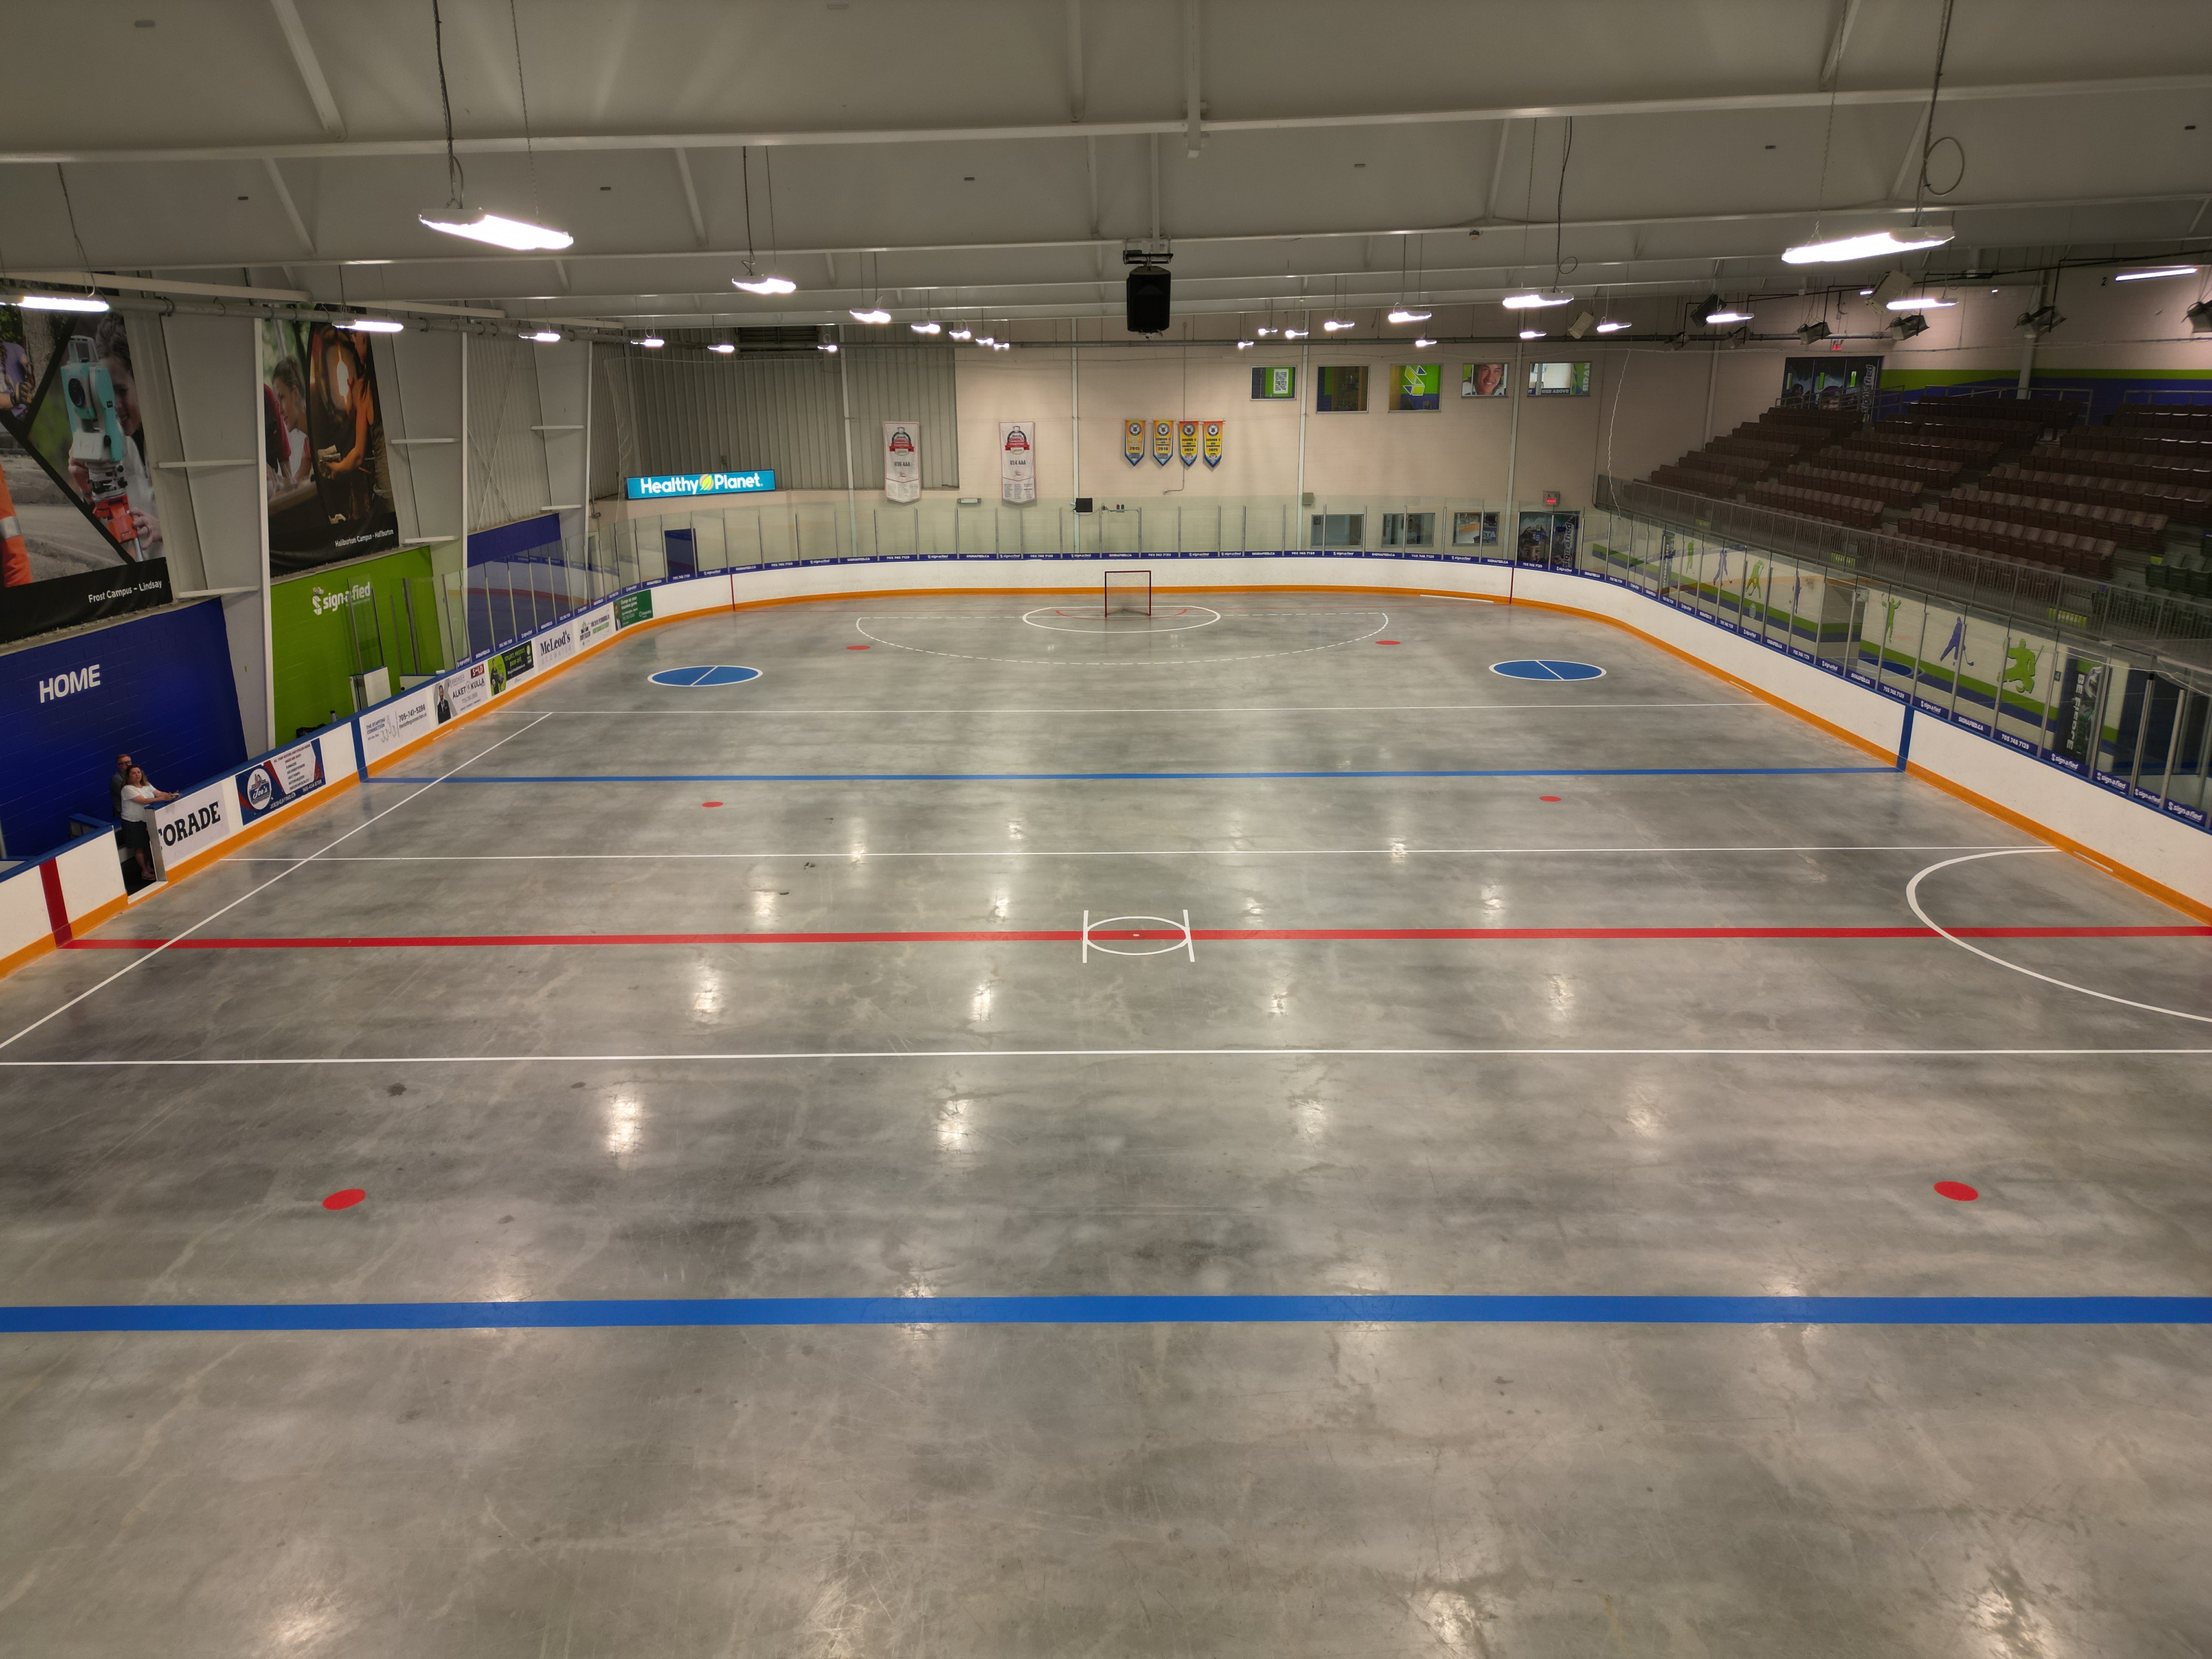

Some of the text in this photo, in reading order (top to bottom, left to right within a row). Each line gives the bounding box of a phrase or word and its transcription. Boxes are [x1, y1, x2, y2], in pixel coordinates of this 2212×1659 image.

[2101, 276, 2107, 286] 2
[641, 473, 760, 494] Healthy Planet
[88, 592, 105, 603] Frost
[106, 587, 132, 598] Campus
[139, 581, 162, 591] Lindsay
[540, 630, 571, 656] McLeod's
[40, 664, 100, 703] HOME
[453, 686, 466, 699] ALKET
[471, 678, 485, 690] KULLA
[2076, 674, 2085, 695] BE
